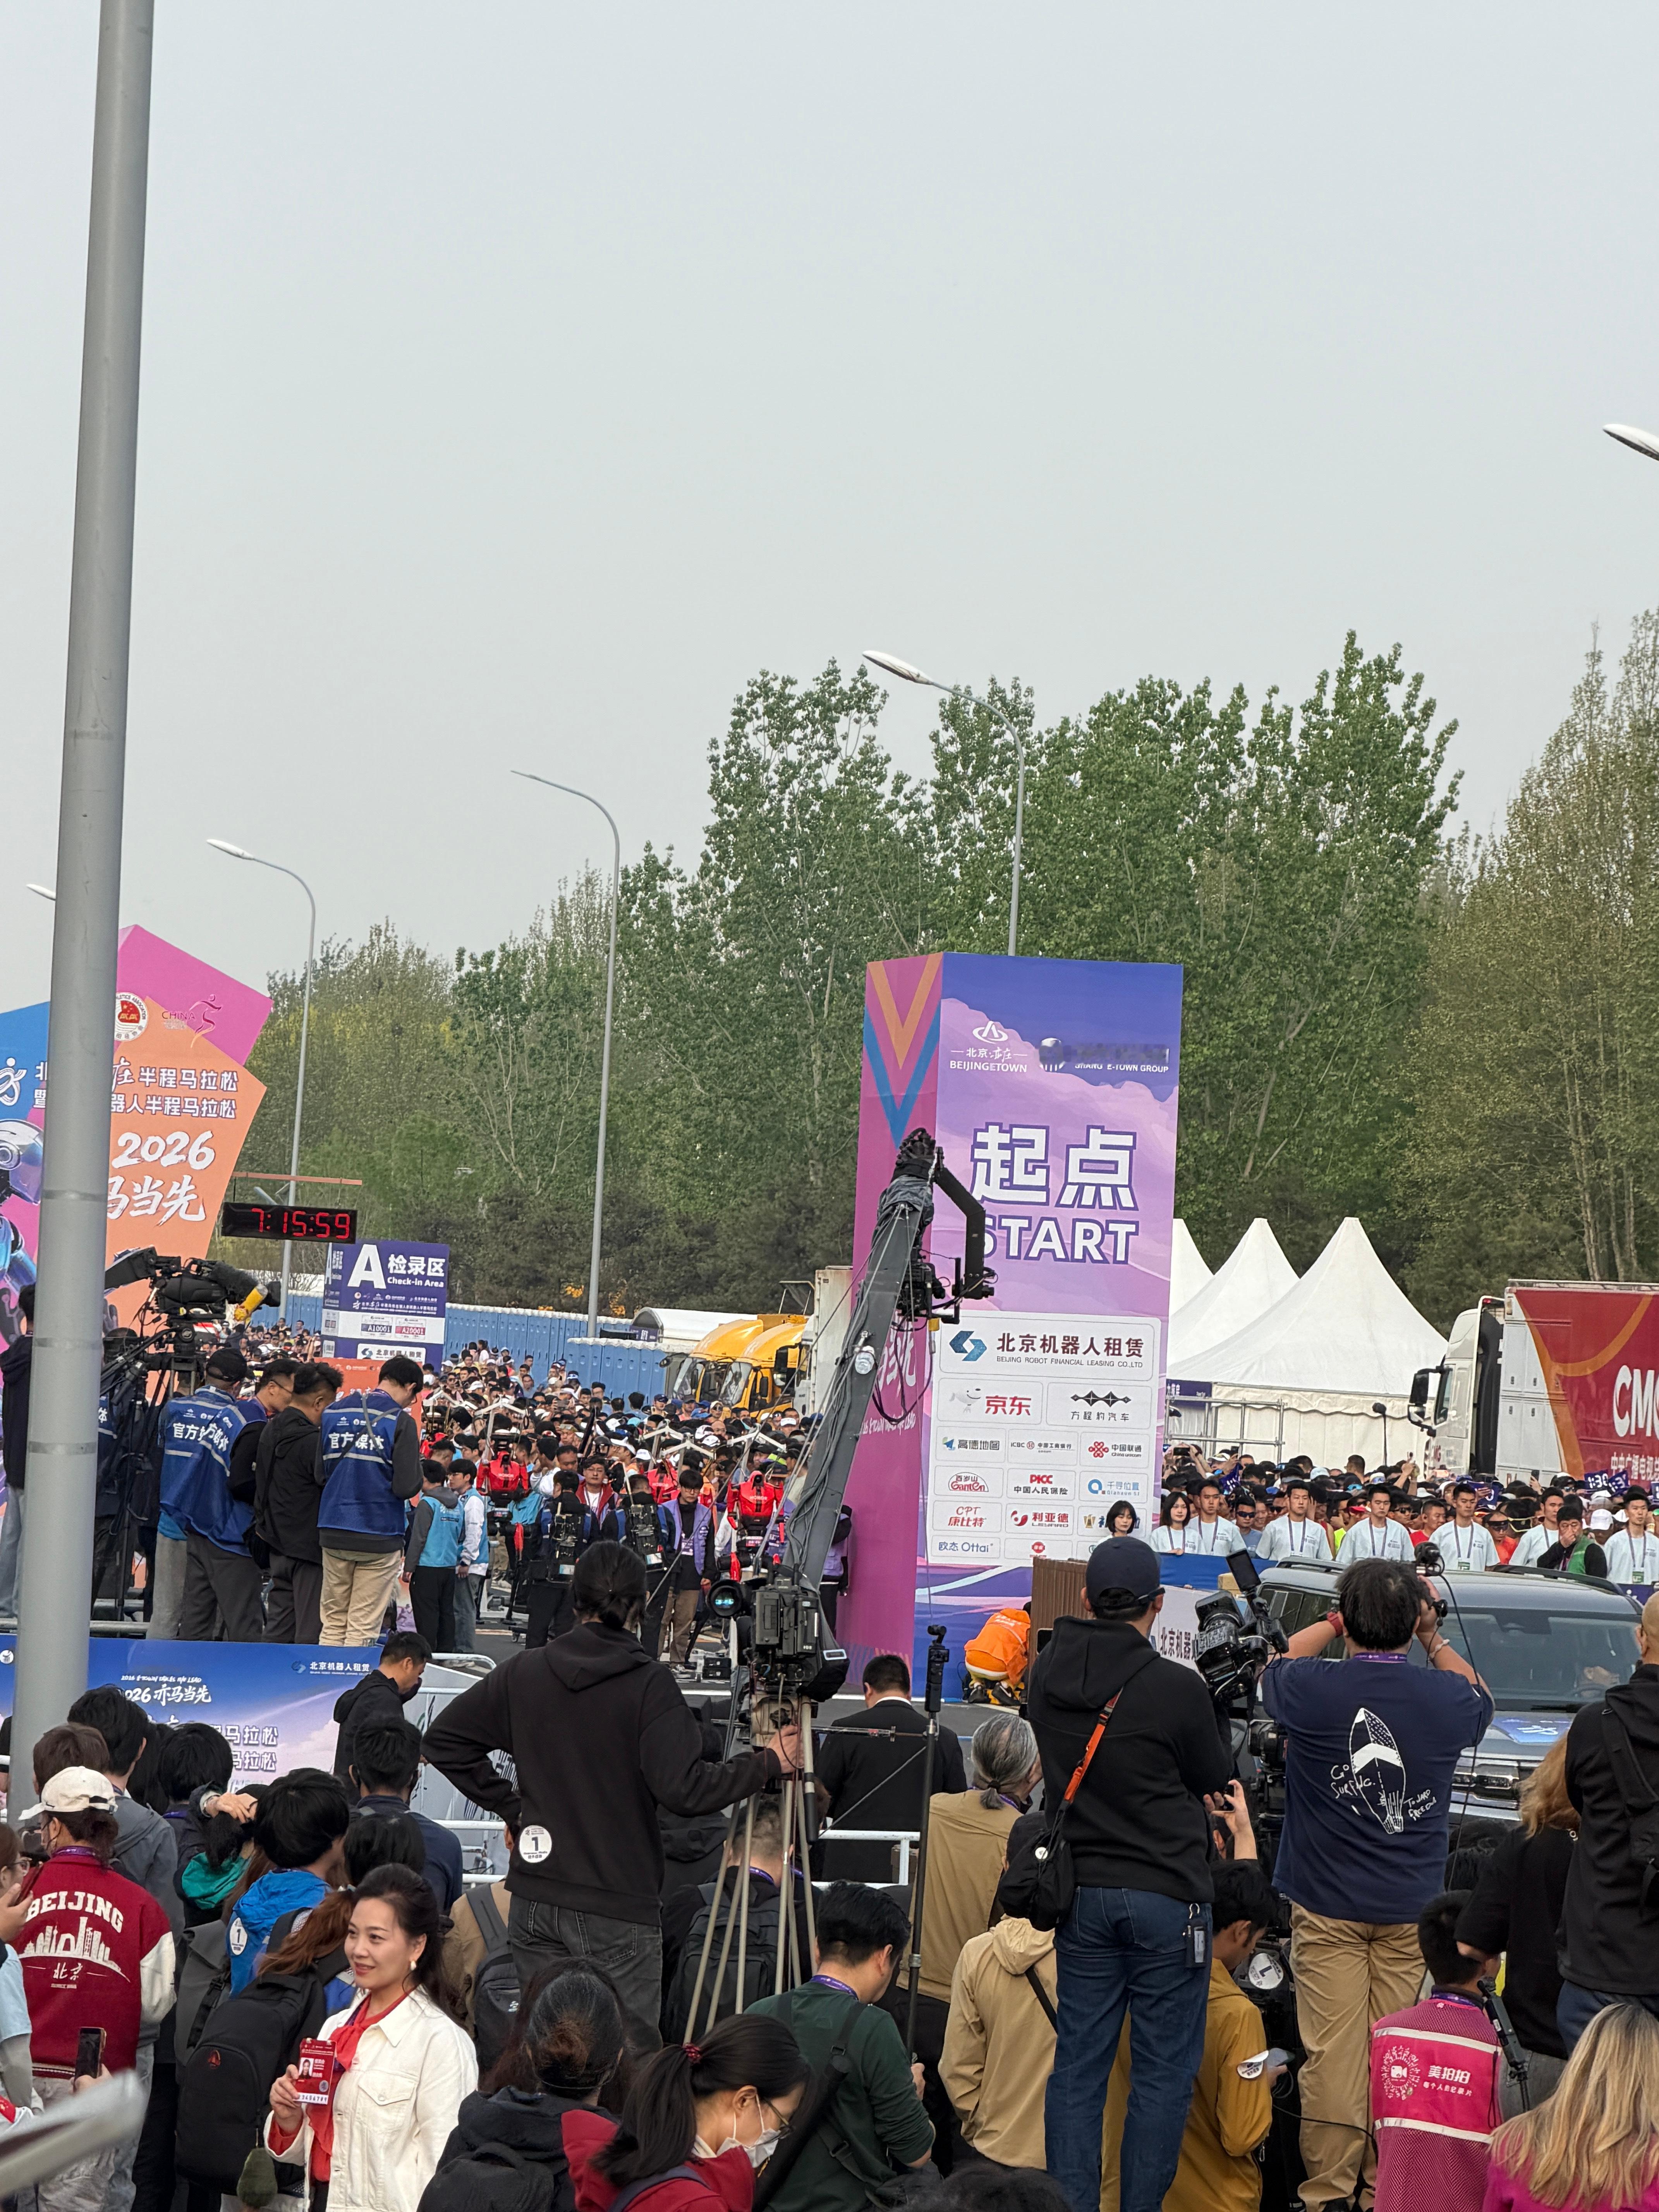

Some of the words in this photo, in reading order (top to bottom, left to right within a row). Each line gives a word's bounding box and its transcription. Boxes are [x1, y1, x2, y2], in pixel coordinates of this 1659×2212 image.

[162, 1011, 196, 1020] CHINA
[1140, 1065, 1169, 1073] GROUP
[112, 1131, 215, 1170] 2026
[970, 1122, 1139, 1211] 起点
[251, 1207, 350, 1239] 7:15:59
[347, 1244, 386, 1289] A
[387, 1254, 446, 1277] 检录区
[387, 1276, 422, 1286] Check-in
[424, 1279, 444, 1288] Area
[996, 1332, 1144, 1358] 北京机器人租赁
[985, 1395, 1032, 1416] 京东
[1070, 1411, 1130, 1422] 方程豹汽车
[958, 1439, 1000, 1451] 高德地图
[1111, 1444, 1142, 1453] 中国联通
[1030, 1474, 1053, 1485] PICC
[1013, 1486, 1068, 1495] 中国人民保险
[956, 1506, 981, 1516] CPT
[948, 1516, 985, 1527] 康比特
[1032, 1512, 1069, 1523] 利亚德
[961, 1542, 989, 1553] Ottai
[309, 1661, 370, 1671] 北京机器人租赁
[122, 1686, 151, 1703] 026
[531, 1836, 539, 1851] 1
[25, 1891, 124, 1934] BEIJING
[1427, 2065, 1471, 2084] 美拍拍
